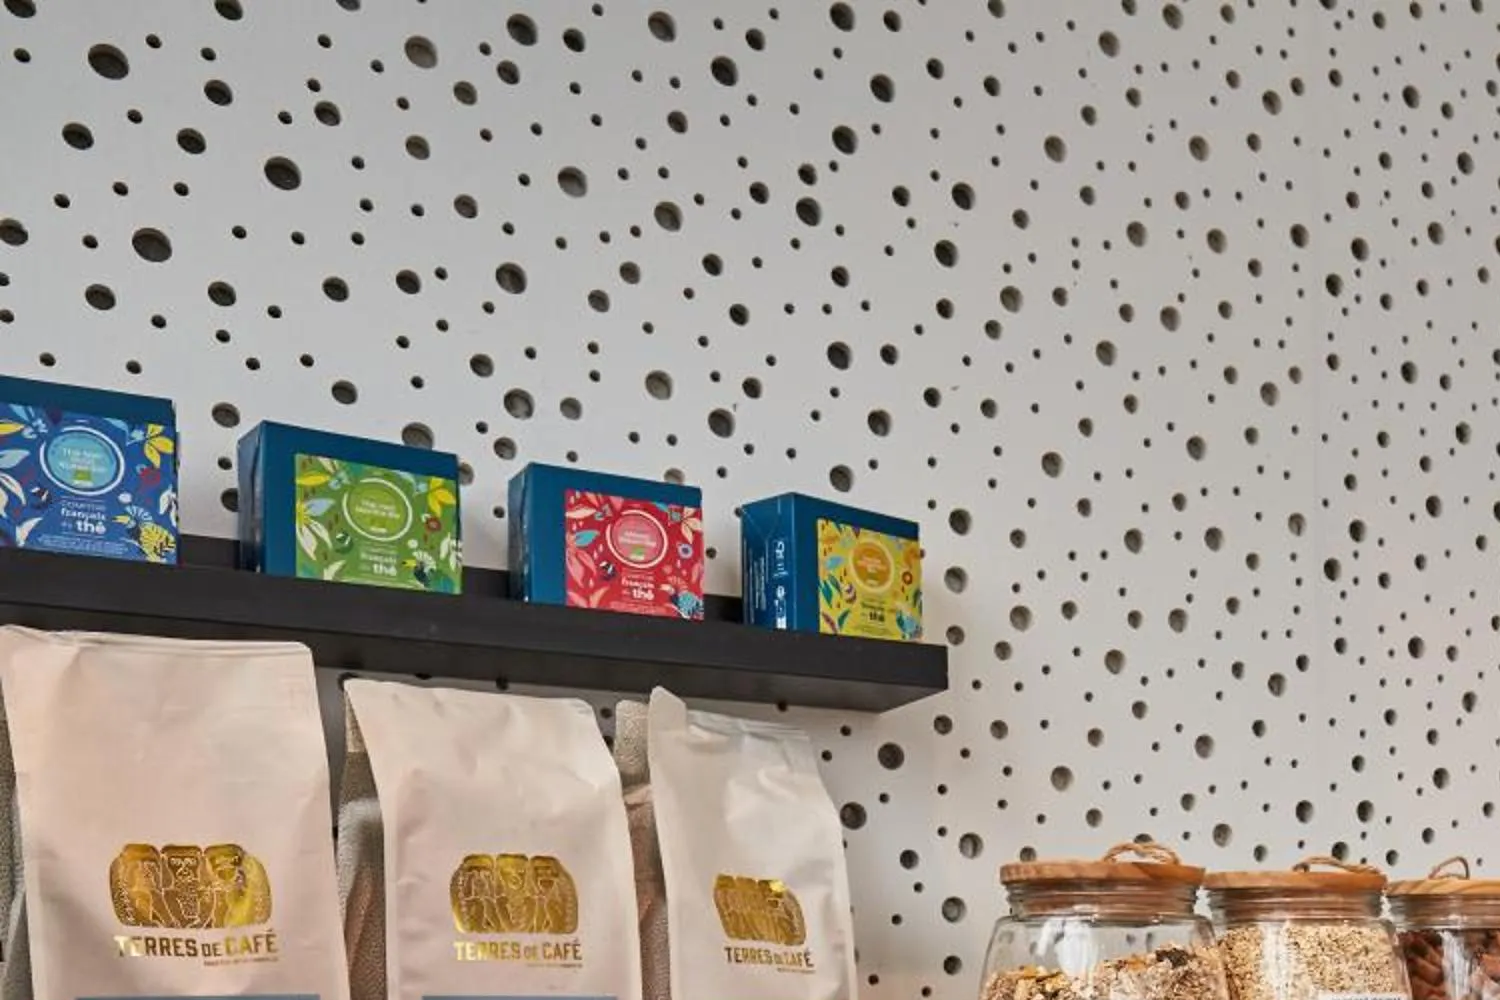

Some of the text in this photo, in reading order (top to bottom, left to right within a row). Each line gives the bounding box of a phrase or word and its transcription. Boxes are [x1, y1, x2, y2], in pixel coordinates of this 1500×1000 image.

[76, 519, 106, 535] thé
[114, 929, 278, 957] TERRES DE CAFÉ
[454, 941, 521, 961] TERRES
[542, 938, 582, 961] CAFÉ
[724, 946, 774, 965] TERRES
[784, 948, 815, 968] CAFÉ
